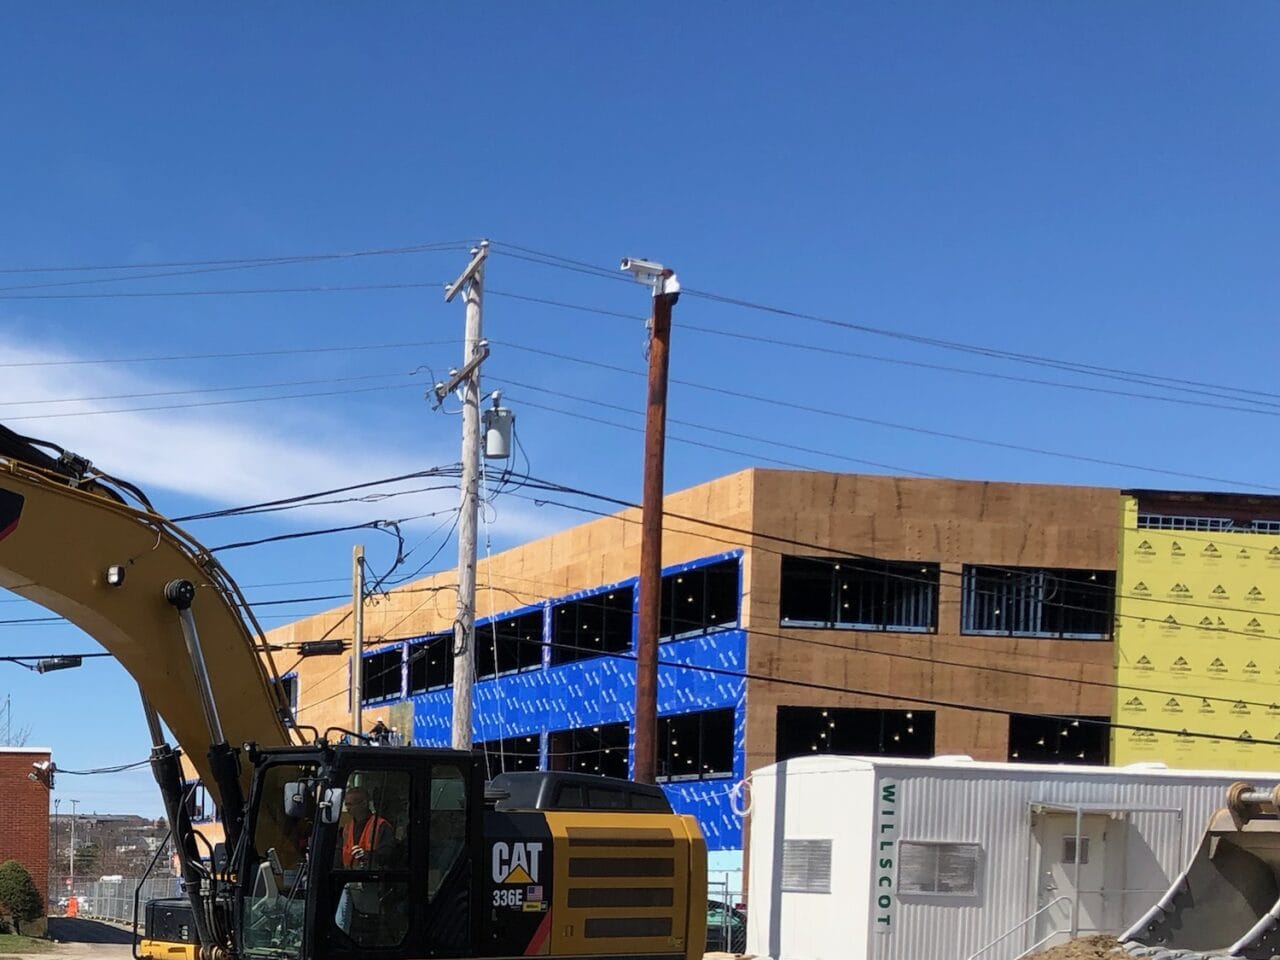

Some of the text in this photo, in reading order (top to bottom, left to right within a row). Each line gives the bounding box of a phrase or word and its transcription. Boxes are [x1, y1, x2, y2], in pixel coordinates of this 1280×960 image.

[492, 841, 543, 884] CAT
[877, 784, 896, 926] WILLSCOT
[492, 889, 523, 907] 336E
